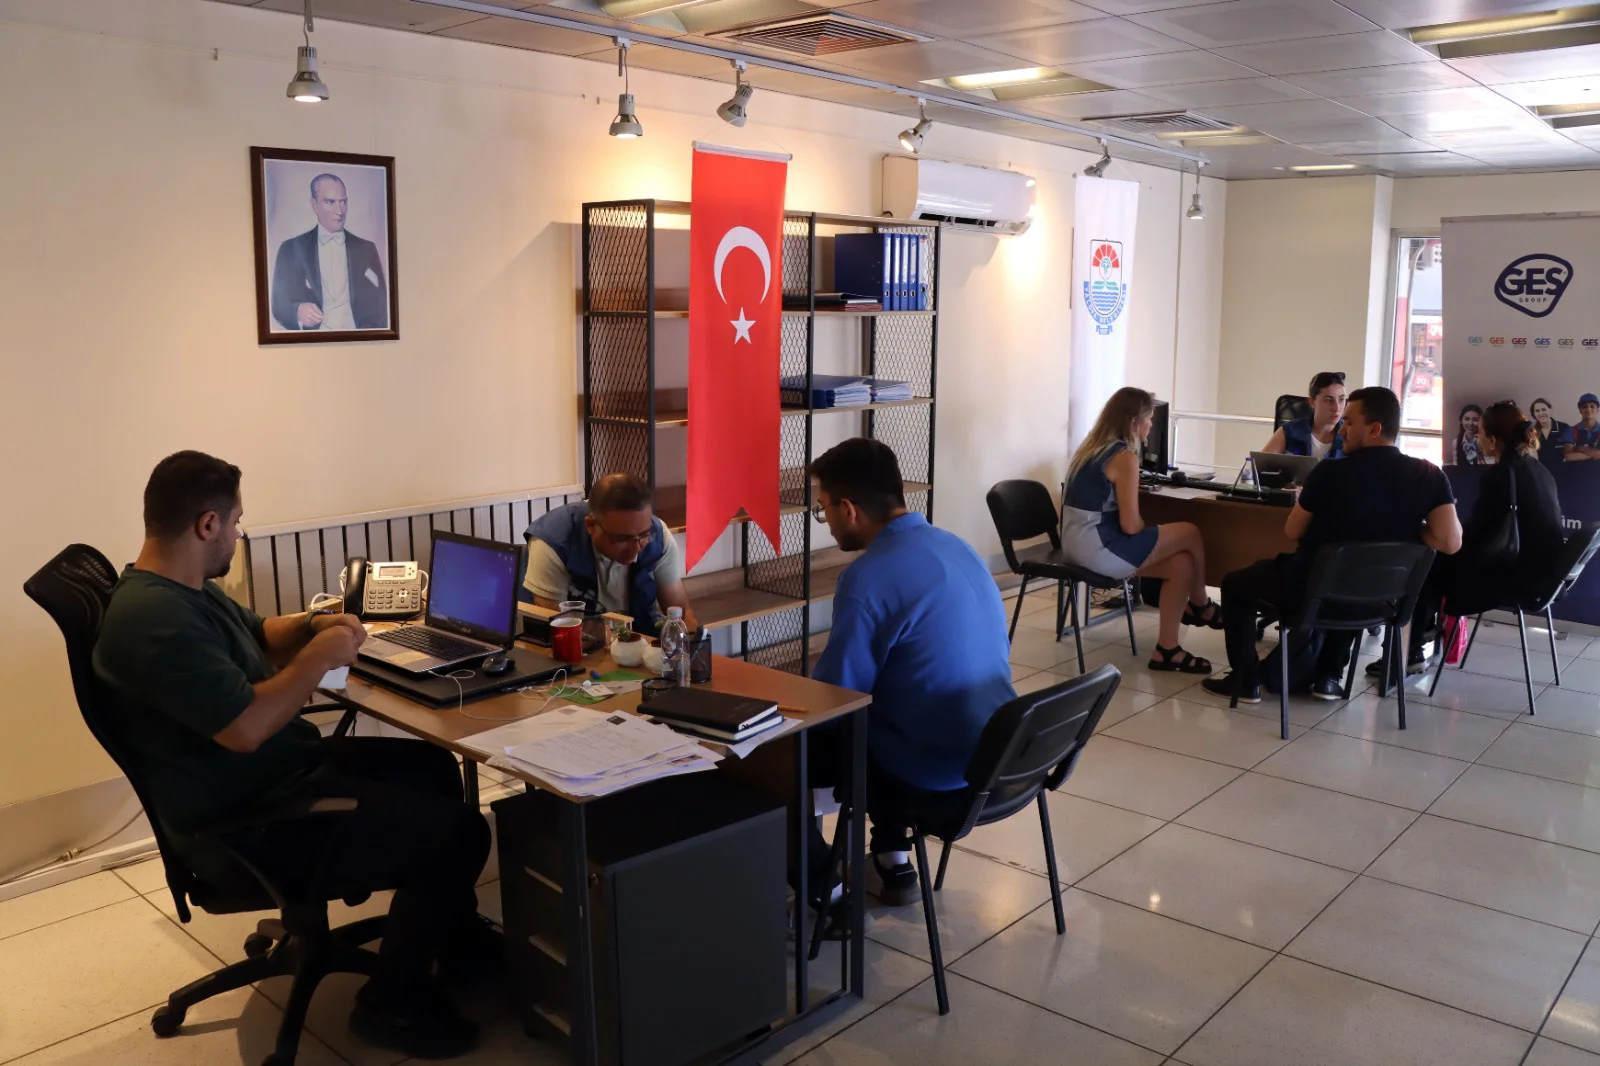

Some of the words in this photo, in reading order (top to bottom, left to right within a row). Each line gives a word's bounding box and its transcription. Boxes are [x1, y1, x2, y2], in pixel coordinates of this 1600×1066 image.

[1499, 267, 1563, 296] GES
[1468, 336, 1483, 344] GES
[1511, 337, 1527, 345] GES
[1557, 338, 1574, 346] GES
[1581, 338, 1599, 346] GES
